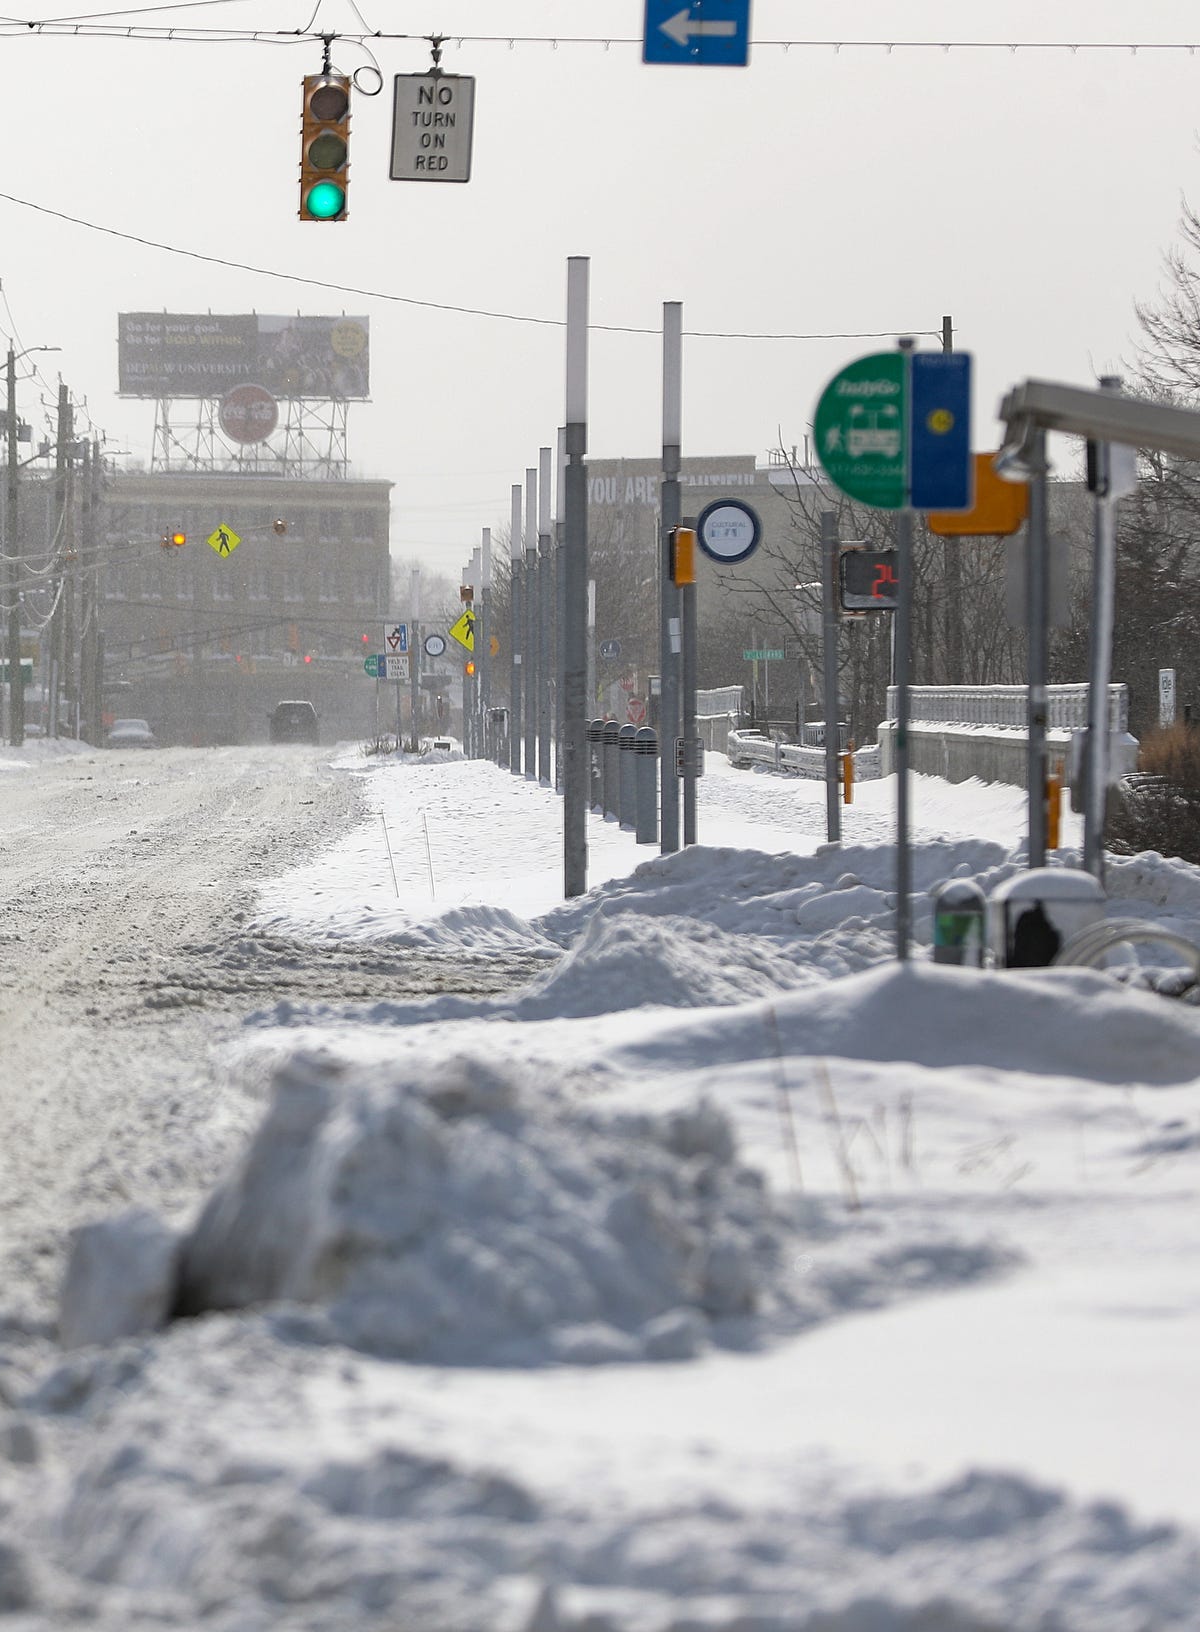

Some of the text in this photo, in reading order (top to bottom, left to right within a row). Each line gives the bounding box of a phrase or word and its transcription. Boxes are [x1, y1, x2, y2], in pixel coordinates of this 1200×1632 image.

[418, 86, 453, 105] NO
[411, 111, 456, 127] TURN
[421, 133, 446, 148] ON
[415, 155, 449, 171] RED
[625, 476, 658, 504] ARE
